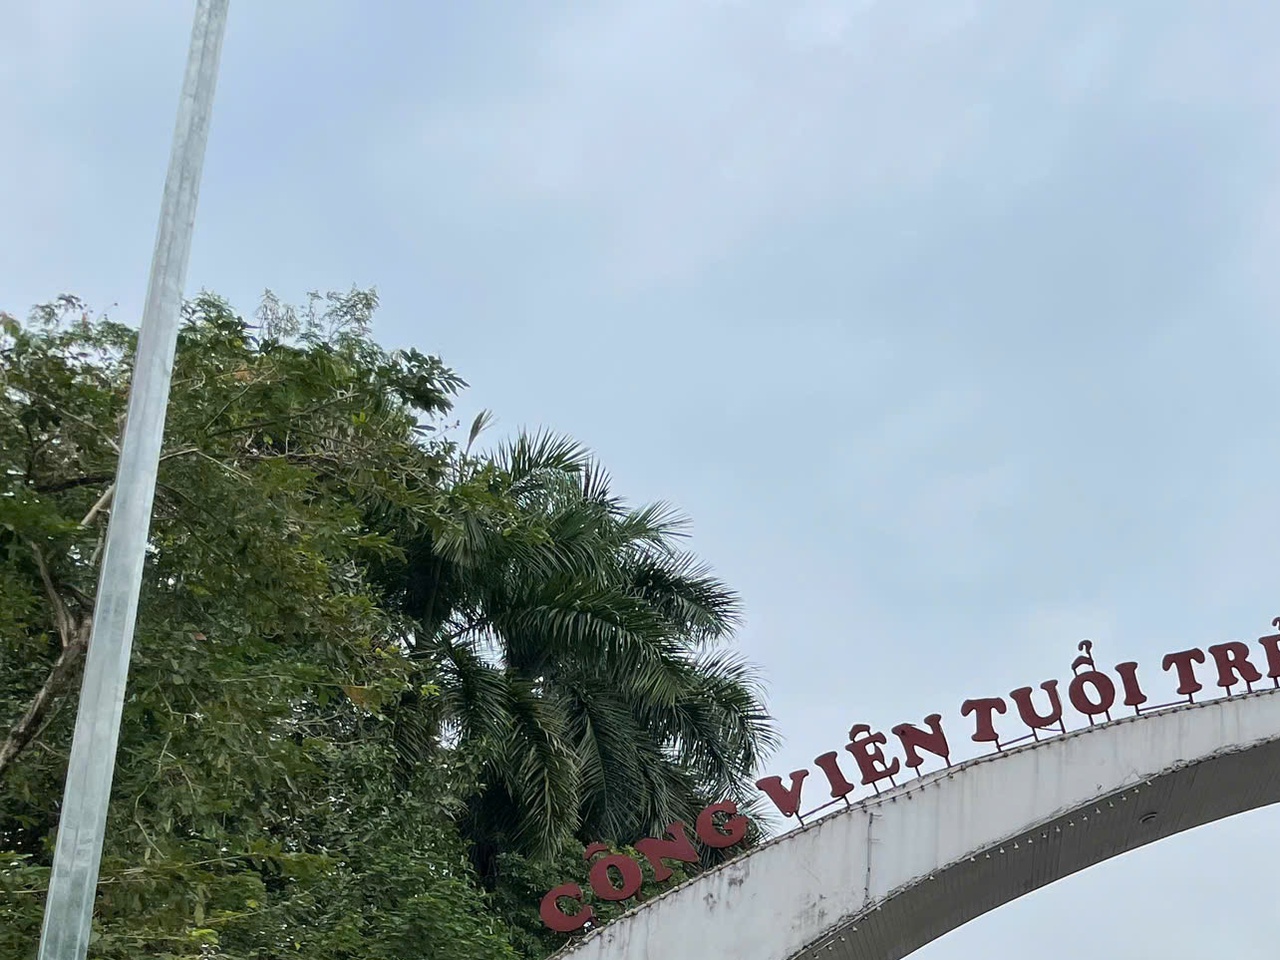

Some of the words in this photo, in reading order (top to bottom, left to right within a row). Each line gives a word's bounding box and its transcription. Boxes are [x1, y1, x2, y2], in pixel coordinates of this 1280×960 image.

[540, 800, 749, 933] CÔNG
[755, 713, 950, 818] VIÊN
[961, 640, 1148, 742] TUỔI
